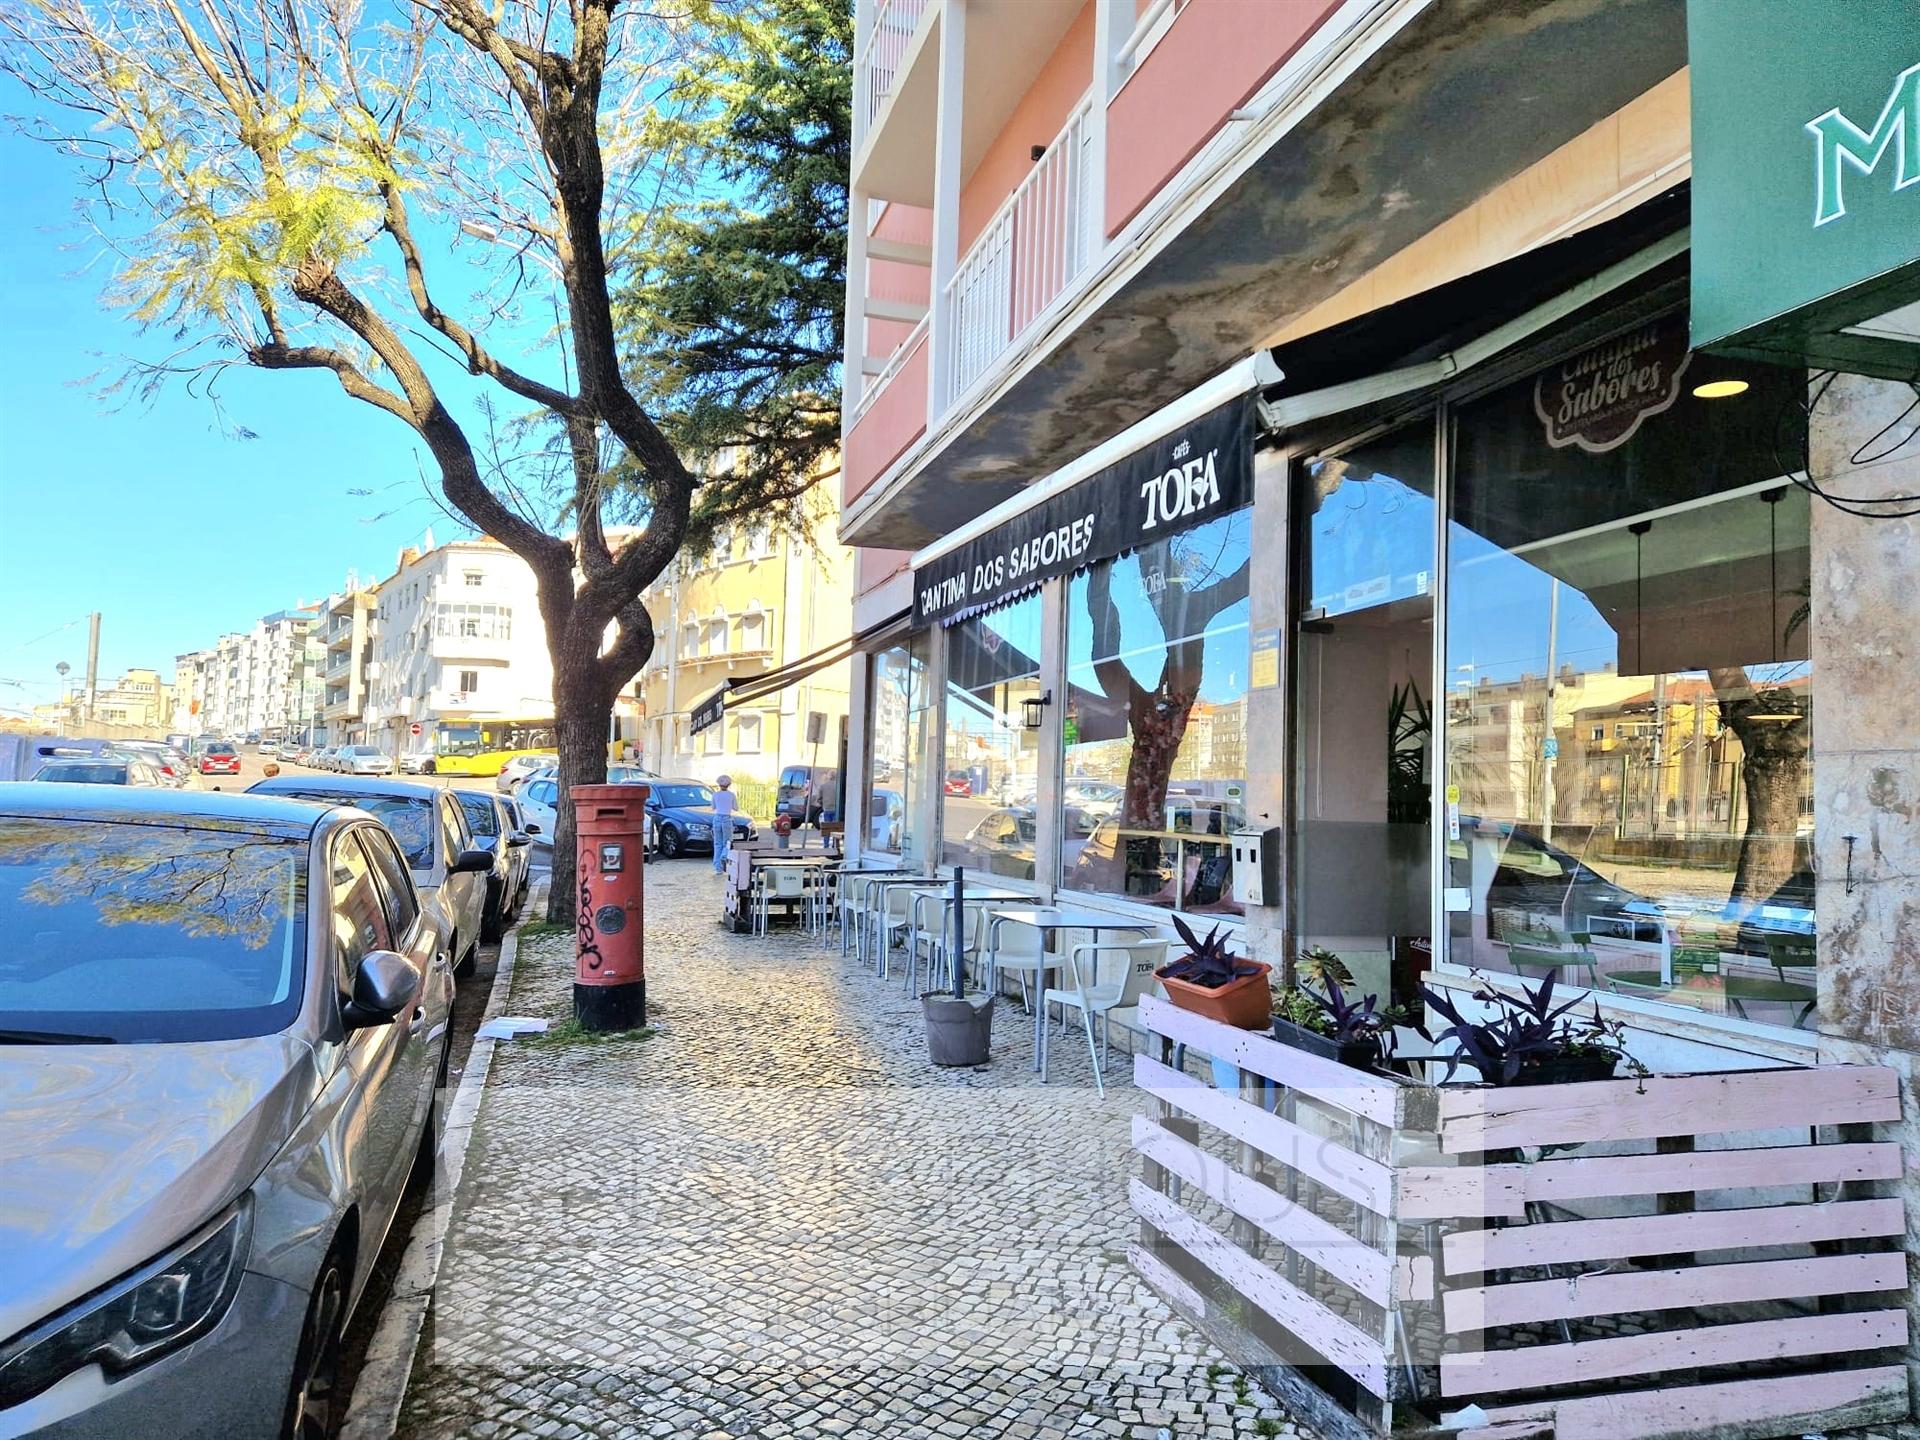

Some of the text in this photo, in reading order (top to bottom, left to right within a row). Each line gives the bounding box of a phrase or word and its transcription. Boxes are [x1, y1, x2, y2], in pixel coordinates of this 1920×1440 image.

[1558, 361, 1661, 424] Sabores
[1140, 450, 1221, 531] TOFA
[972, 556, 1005, 595] DOS
[1009, 513, 1096, 577] SABORES
